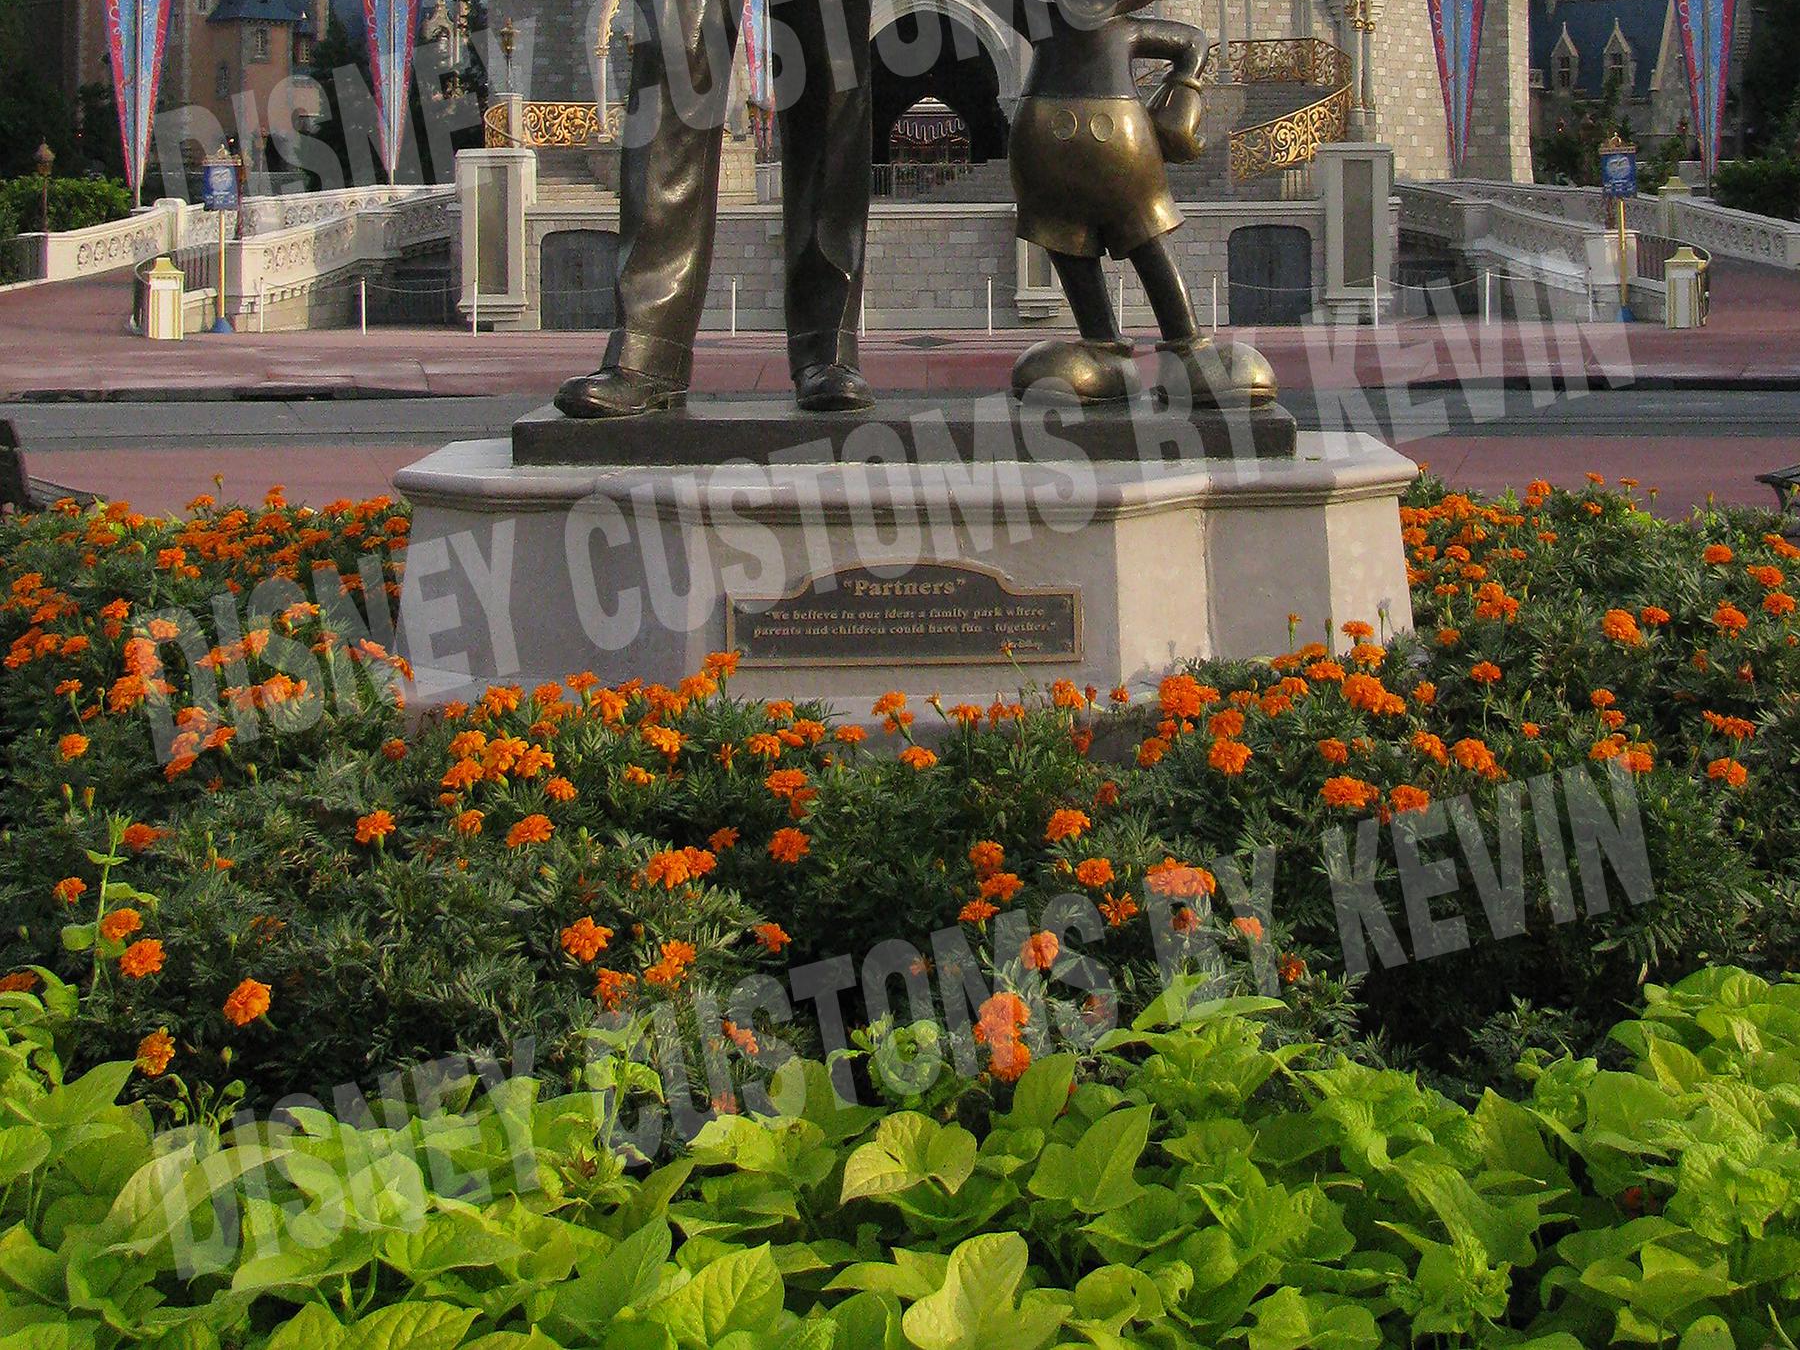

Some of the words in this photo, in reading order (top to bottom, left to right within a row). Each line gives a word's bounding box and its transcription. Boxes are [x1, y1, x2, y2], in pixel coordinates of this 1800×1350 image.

[843, 578, 966, 596] "Partners"
[793, 609, 838, 620] believe
[858, 611, 880, 620] our
[928, 607, 969, 620] family
[973, 607, 1002, 620] park
[1006, 606, 1044, 617] where
[754, 626, 801, 638] parents
[804, 624, 829, 635] and
[831, 624, 885, 635] children
[889, 624, 924, 634] could
[928, 623, 957, 634] have
[961, 623, 983, 634] fun
